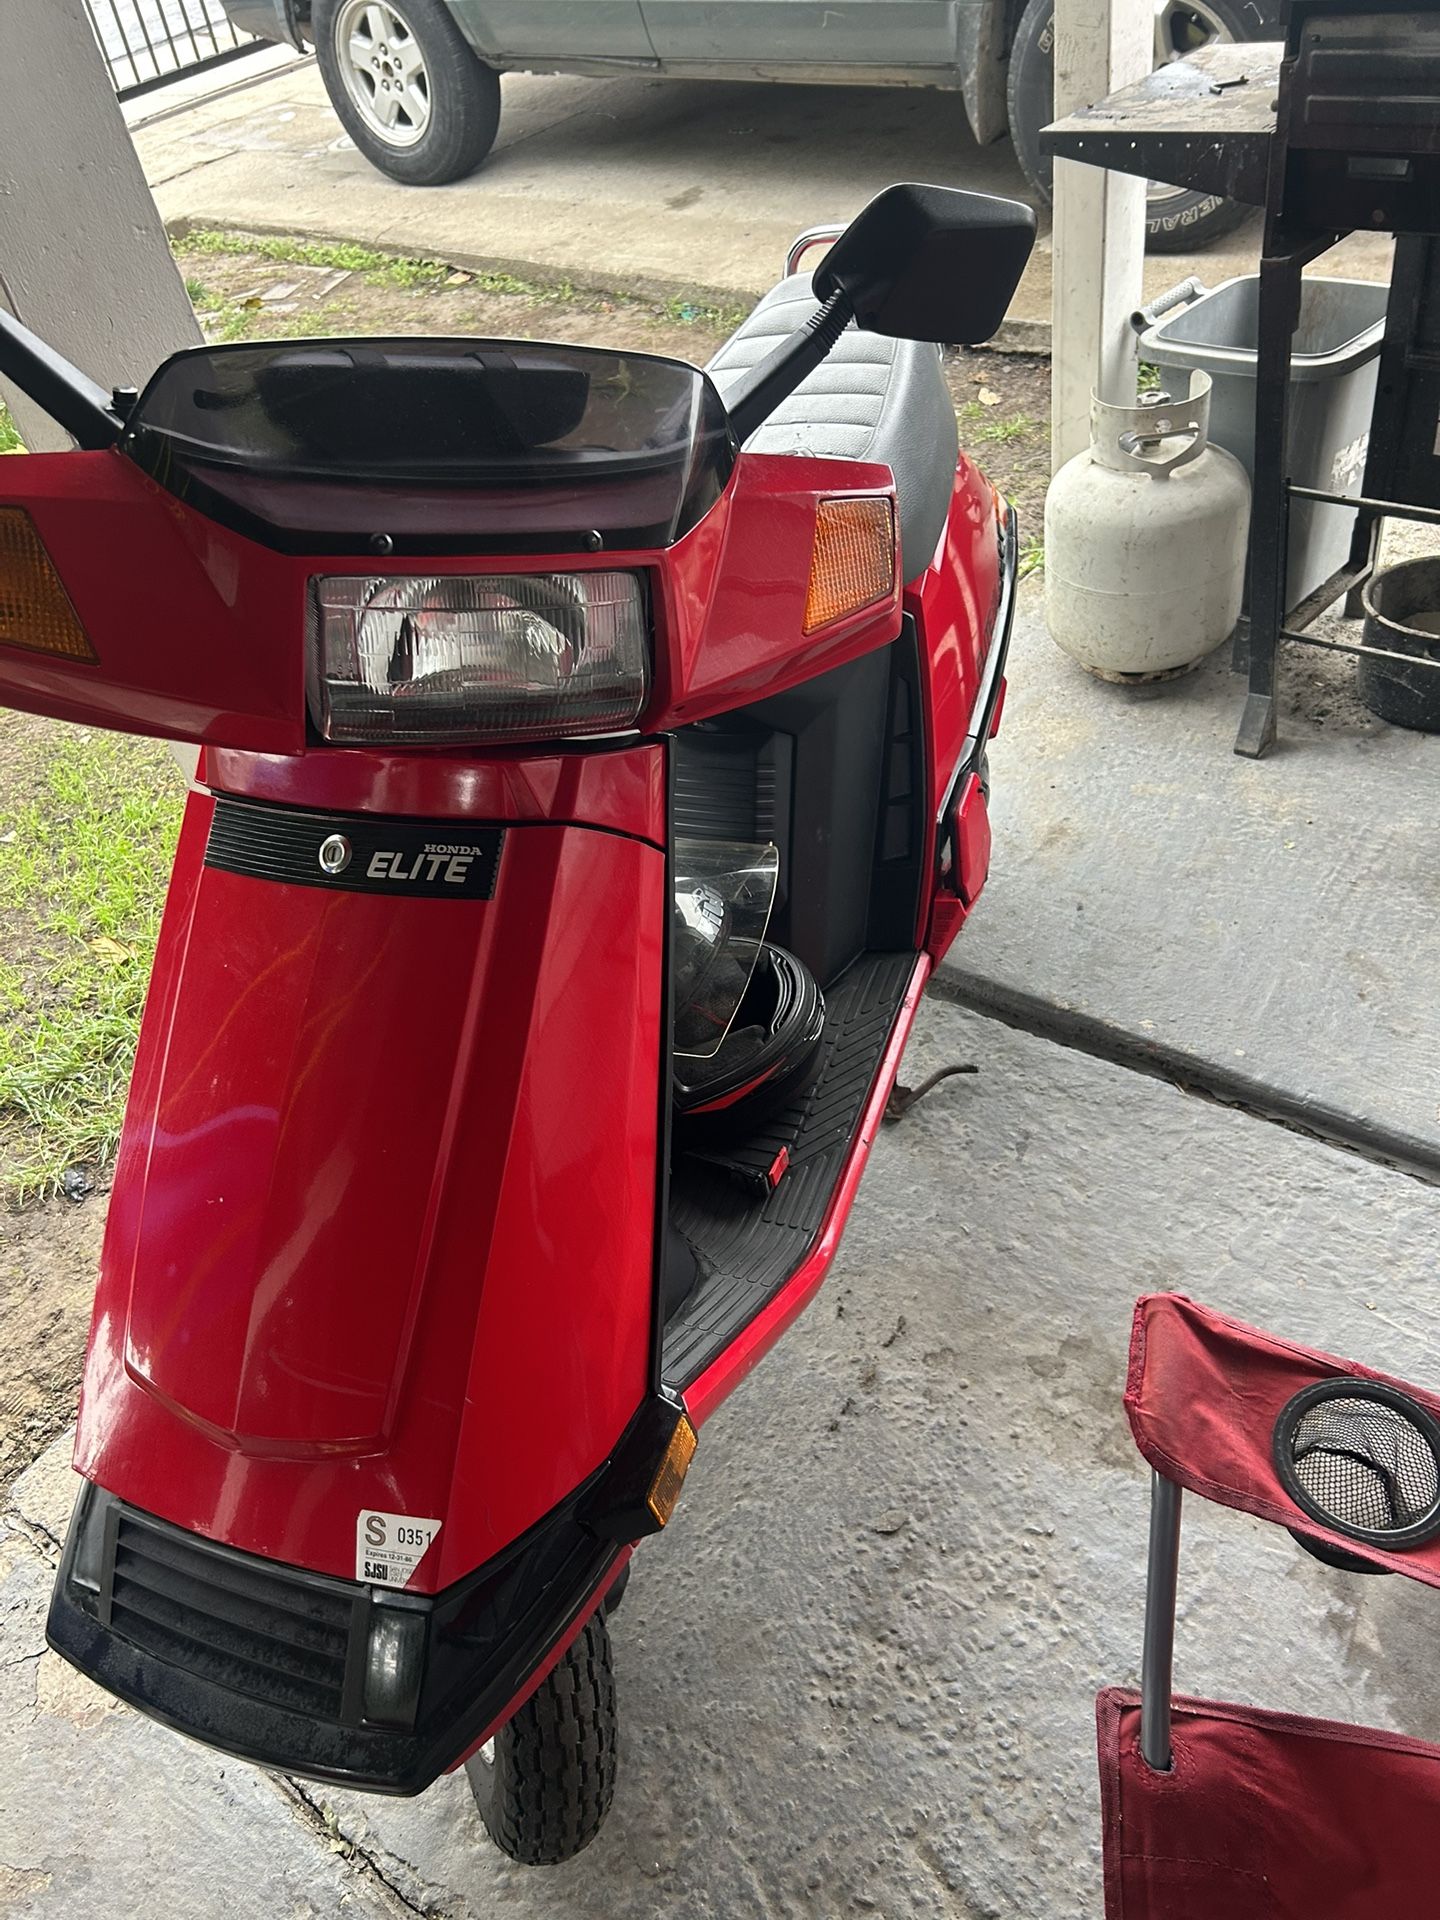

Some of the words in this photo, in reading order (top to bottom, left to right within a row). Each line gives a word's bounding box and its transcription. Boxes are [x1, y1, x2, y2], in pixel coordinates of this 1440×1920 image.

[424, 844, 482, 856] HONDA
[367, 852, 474, 882] ELITE
[365, 1516, 386, 1546] S
[398, 1527, 432, 1546] 0351
[365, 1550, 387, 1558] Expires
[365, 1561, 388, 1580] SJSU
